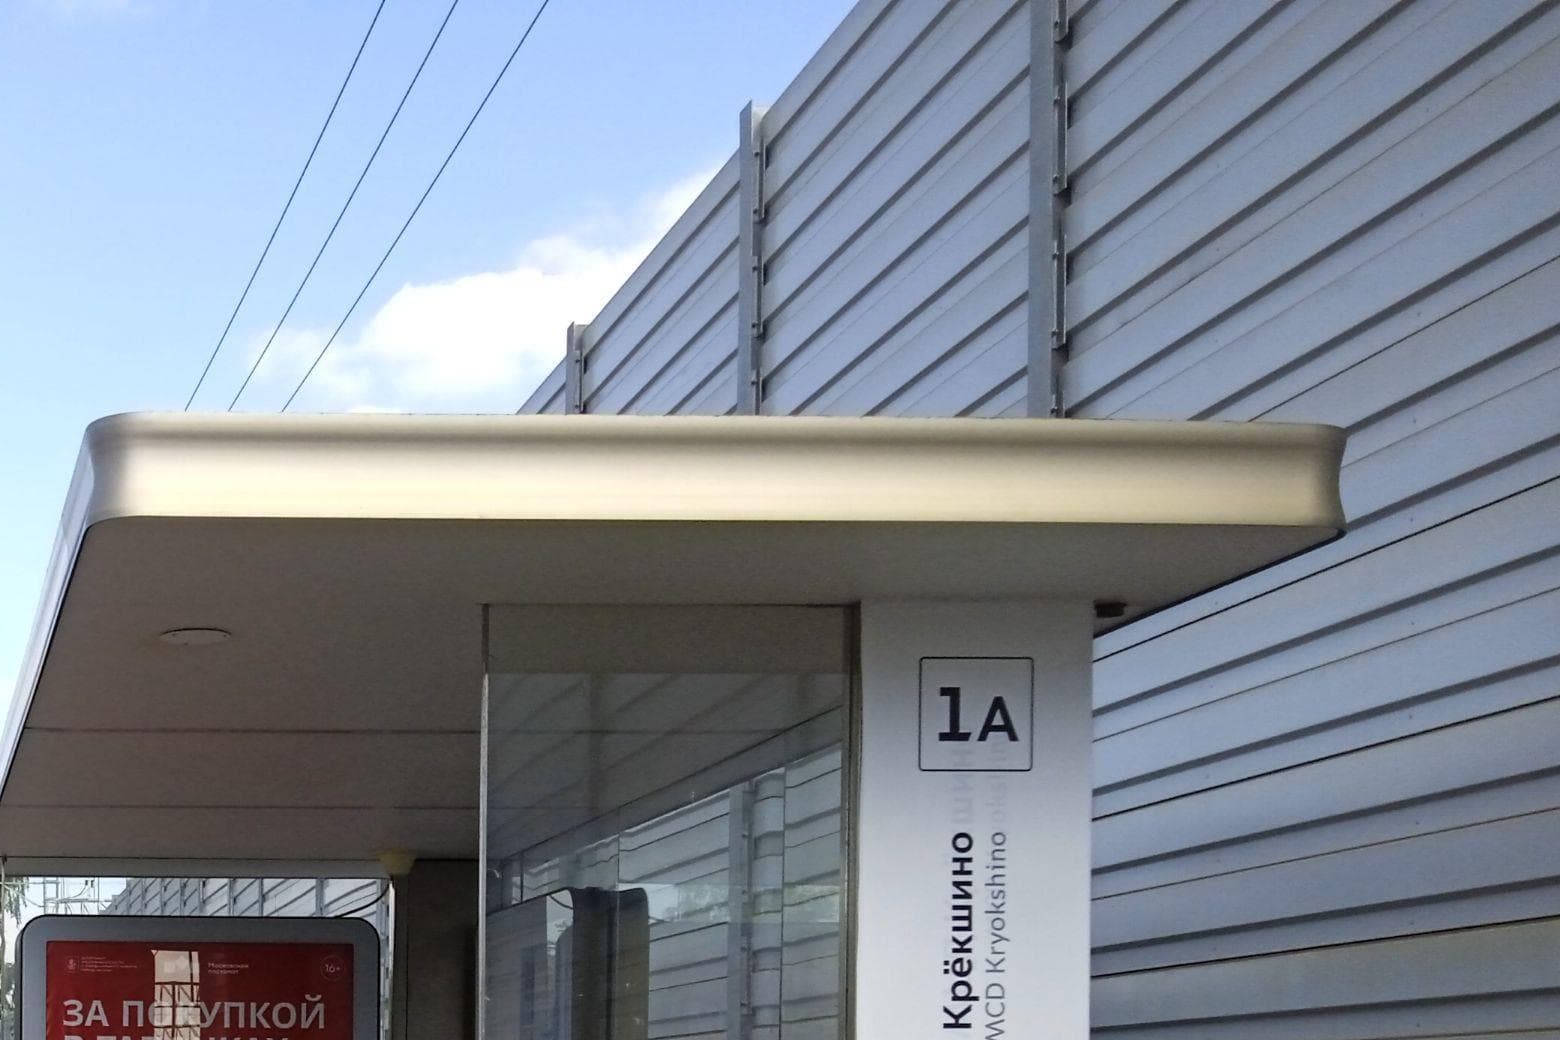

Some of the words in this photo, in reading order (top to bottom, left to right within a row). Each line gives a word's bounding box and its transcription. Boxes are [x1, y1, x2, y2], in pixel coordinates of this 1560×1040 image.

[943, 832, 979, 1029] Крёкшино
[984, 832, 1011, 973] Kryokshino
[63, 999, 110, 1027] ЗА
[122, 994, 325, 1029] ПУПКОЙ
[325, 963, 340, 973] 16+
